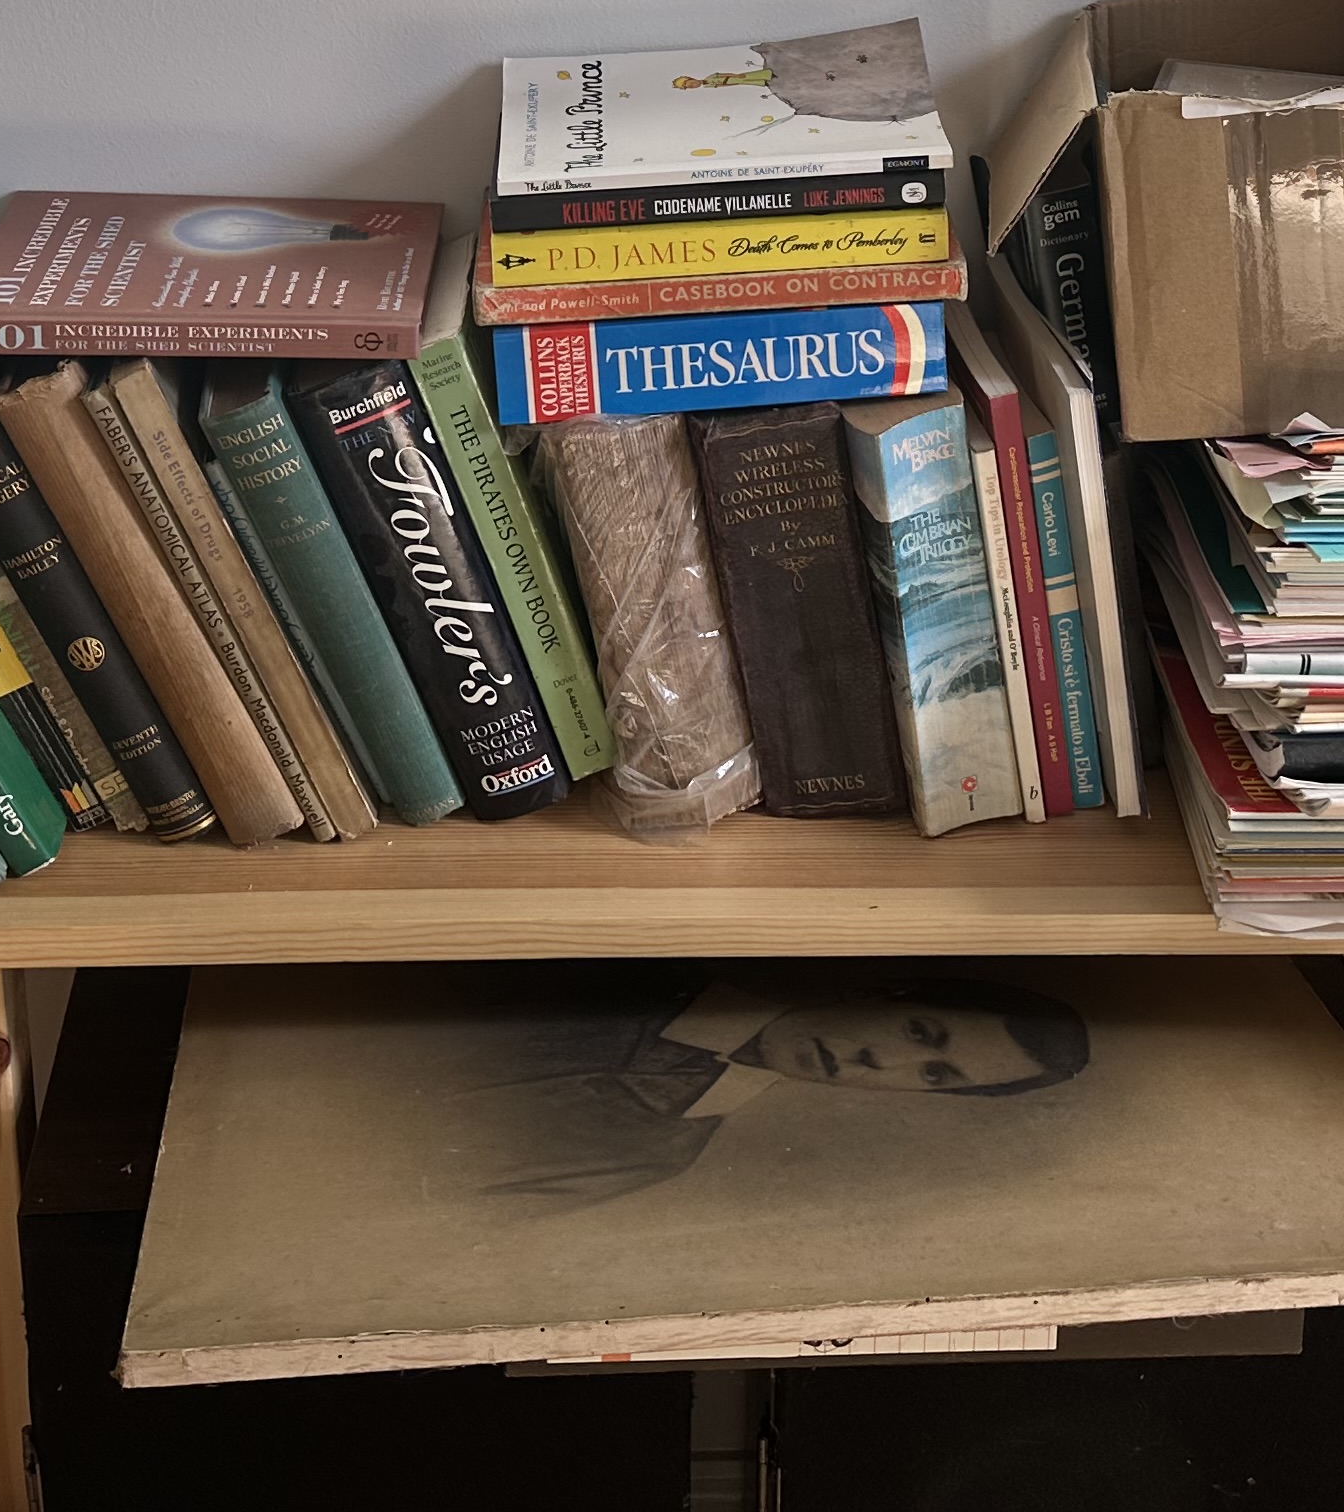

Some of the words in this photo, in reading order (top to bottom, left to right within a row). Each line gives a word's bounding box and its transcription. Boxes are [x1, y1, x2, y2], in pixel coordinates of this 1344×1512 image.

[565, 60, 603, 115] Prince
[566, 119, 607, 152] Little
[691, 169, 734, 179] ANTOINE
[737, 167, 751, 177] DE
[562, 201, 615, 224] KILLING
[620, 199, 646, 220] EVE
[654, 196, 721, 216] CODENAME
[725, 193, 792, 215] VILLANELLE
[803, 190, 829, 207] LUKE
[832, 187, 885, 205] JENNINGS
[1042, 199, 1078, 214] Collins
[1043, 209, 1081, 231] gem
[13, 198, 70, 273] INCREDIBLE
[547, 245, 601, 271] P.D.
[611, 238, 716, 273] JAMES
[728, 235, 773, 256] Death
[779, 235, 819, 254] Comes
[837, 228, 908, 256] Pemberley
[29, 217, 92, 306] EXPERIMENTS
[64, 278, 94, 306] FOR
[80, 251, 108, 276] THE
[95, 216, 126, 249] SHED
[100, 240, 147, 307] SCIENTIST
[551, 293, 640, 309] Powell-Smith
[660, 276, 776, 303] CASEBOOK
[787, 273, 818, 293] ON
[829, 268, 949, 292] CONTRACT
[55, 325, 179, 338] INCREDIBLE
[188, 326, 329, 340] EXPERIMENTS
[55, 339, 88, 350] FOR
[95, 340, 128, 351] THE
[135, 340, 180, 352] SHED
[187, 341, 276, 353] SCIENTIST
[536, 337, 560, 417] COLLINS
[556, 336, 575, 414] PAPERBACK
[570, 335, 590, 414] THESAURUS
[606, 330, 885, 395] THESAURUS
[328, 381, 407, 425] Burchfield
[152, 430, 173, 462] Side
[217, 413, 285, 450] ENGLISH
[339, 430, 376, 452] THE
[232, 439, 292, 469] SOCIAL
[738, 439, 816, 465] NEWNES
[167, 460, 196, 509] Effects
[236, 455, 303, 491] HISTORY
[735, 457, 825, 484] WIRELESS
[984, 473, 998, 495] Top
[192, 506, 205, 522] of
[911, 509, 942, 529] THE
[987, 498, 1002, 523] Tips
[1041, 491, 1056, 528] Carlo
[198, 521, 223, 563] Drugs
[450, 404, 481, 451] THE
[469, 451, 518, 541] PIRATES
[505, 541, 540, 600] OWN
[524, 596, 562, 655] BOOK
[784, 534, 836, 551] CAMM
[1045, 528, 1060, 557] Levi
[3, 535, 63, 570] HAMILTON
[16, 552, 62, 580] BAILEY
[367, 425, 514, 707] Fowler's
[993, 537, 1011, 582] Urology
[95, 404, 139, 470] FABER'S
[128, 469, 195, 580] ANATOMICAL
[187, 573, 223, 630] ATLAS
[220, 641, 253, 700] Burdon,
[289, 772, 327, 830] Maxwell
[232, 588, 256, 620] 1958
[459, 706, 535, 743] MODERN
[1056, 618, 1073, 664] Cristo
[1066, 690, 1082, 744] fermato
[1075, 754, 1094, 796] Eboli
[120, 736, 162, 761] EDITION
[467, 720, 539, 756] ENGLISH
[481, 739, 536, 767] USAGE
[480, 753, 555, 793] Oxford
[795, 774, 865, 796] NEWNES
